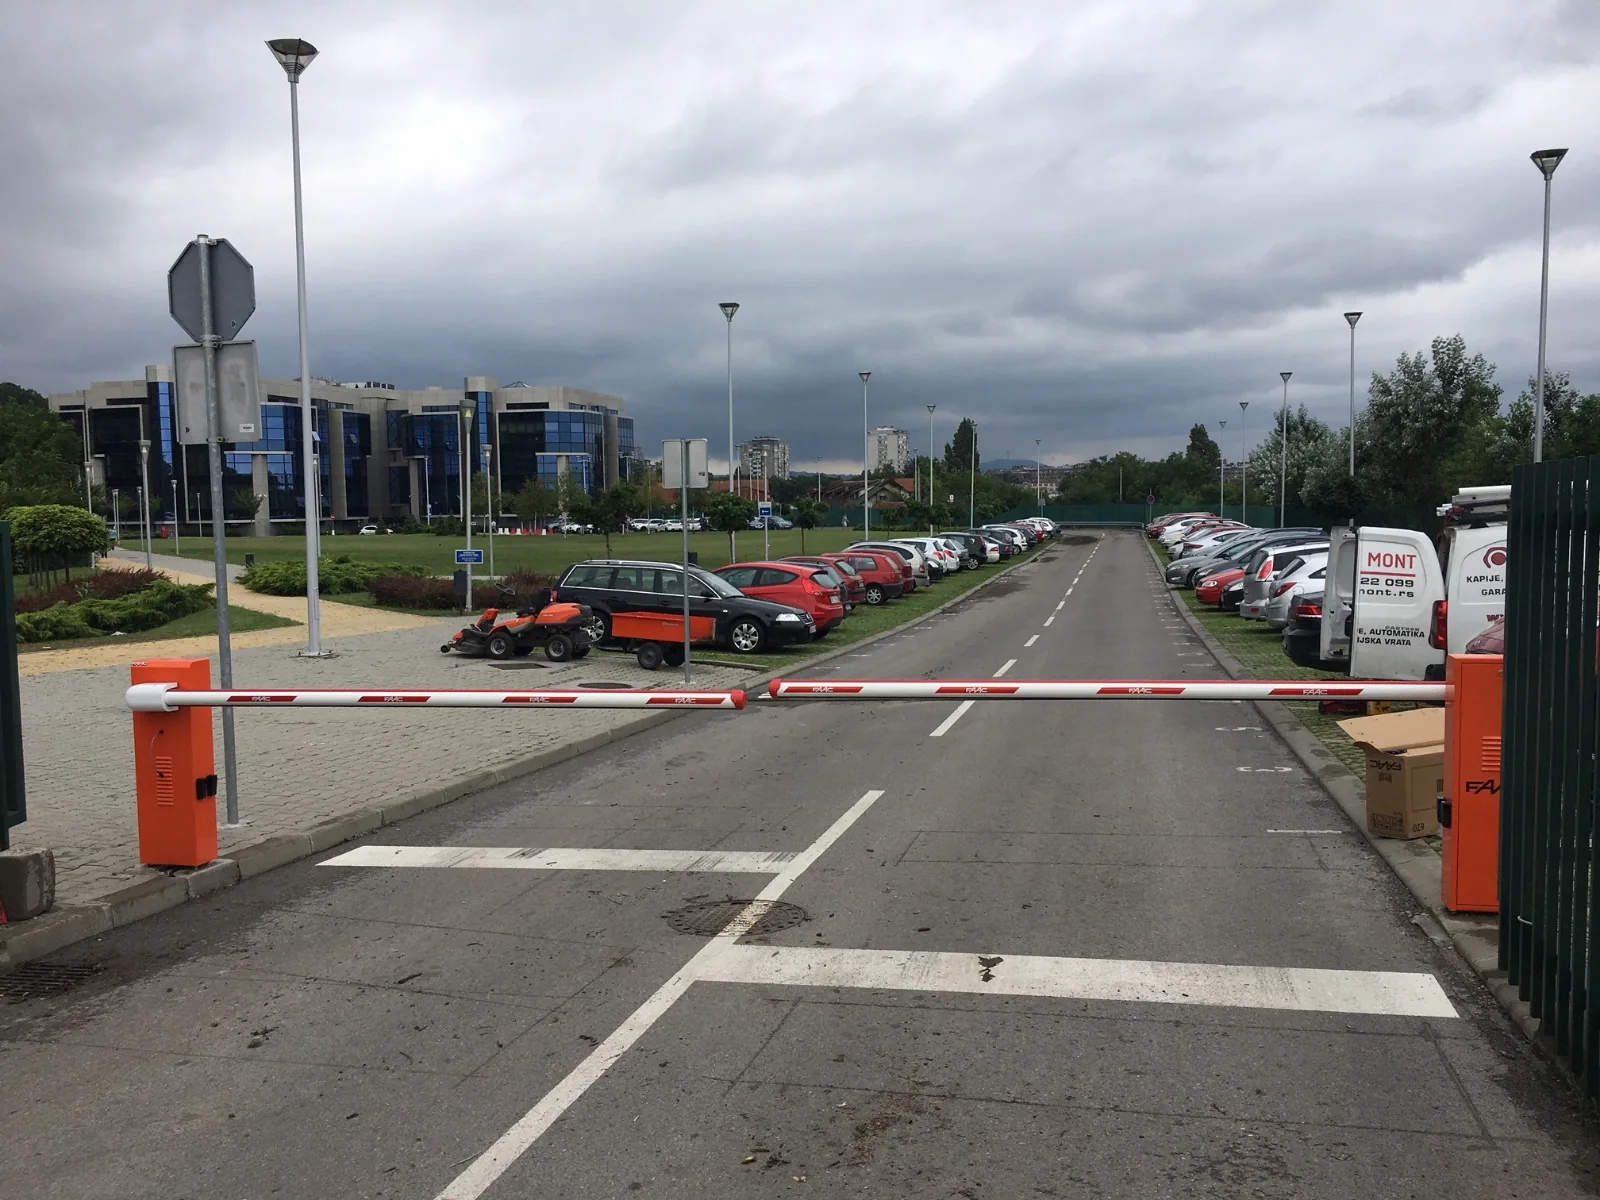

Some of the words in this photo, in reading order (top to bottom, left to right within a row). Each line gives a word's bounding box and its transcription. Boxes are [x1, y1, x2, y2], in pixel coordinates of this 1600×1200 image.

[1367, 552, 1416, 569] MONT
[1385, 578, 1414, 587] 099
[1466, 575, 1504, 583] KAPIJE,
[1369, 628, 1425, 638] AUTOMATIKA
[1384, 638, 1411, 646] VRATA
